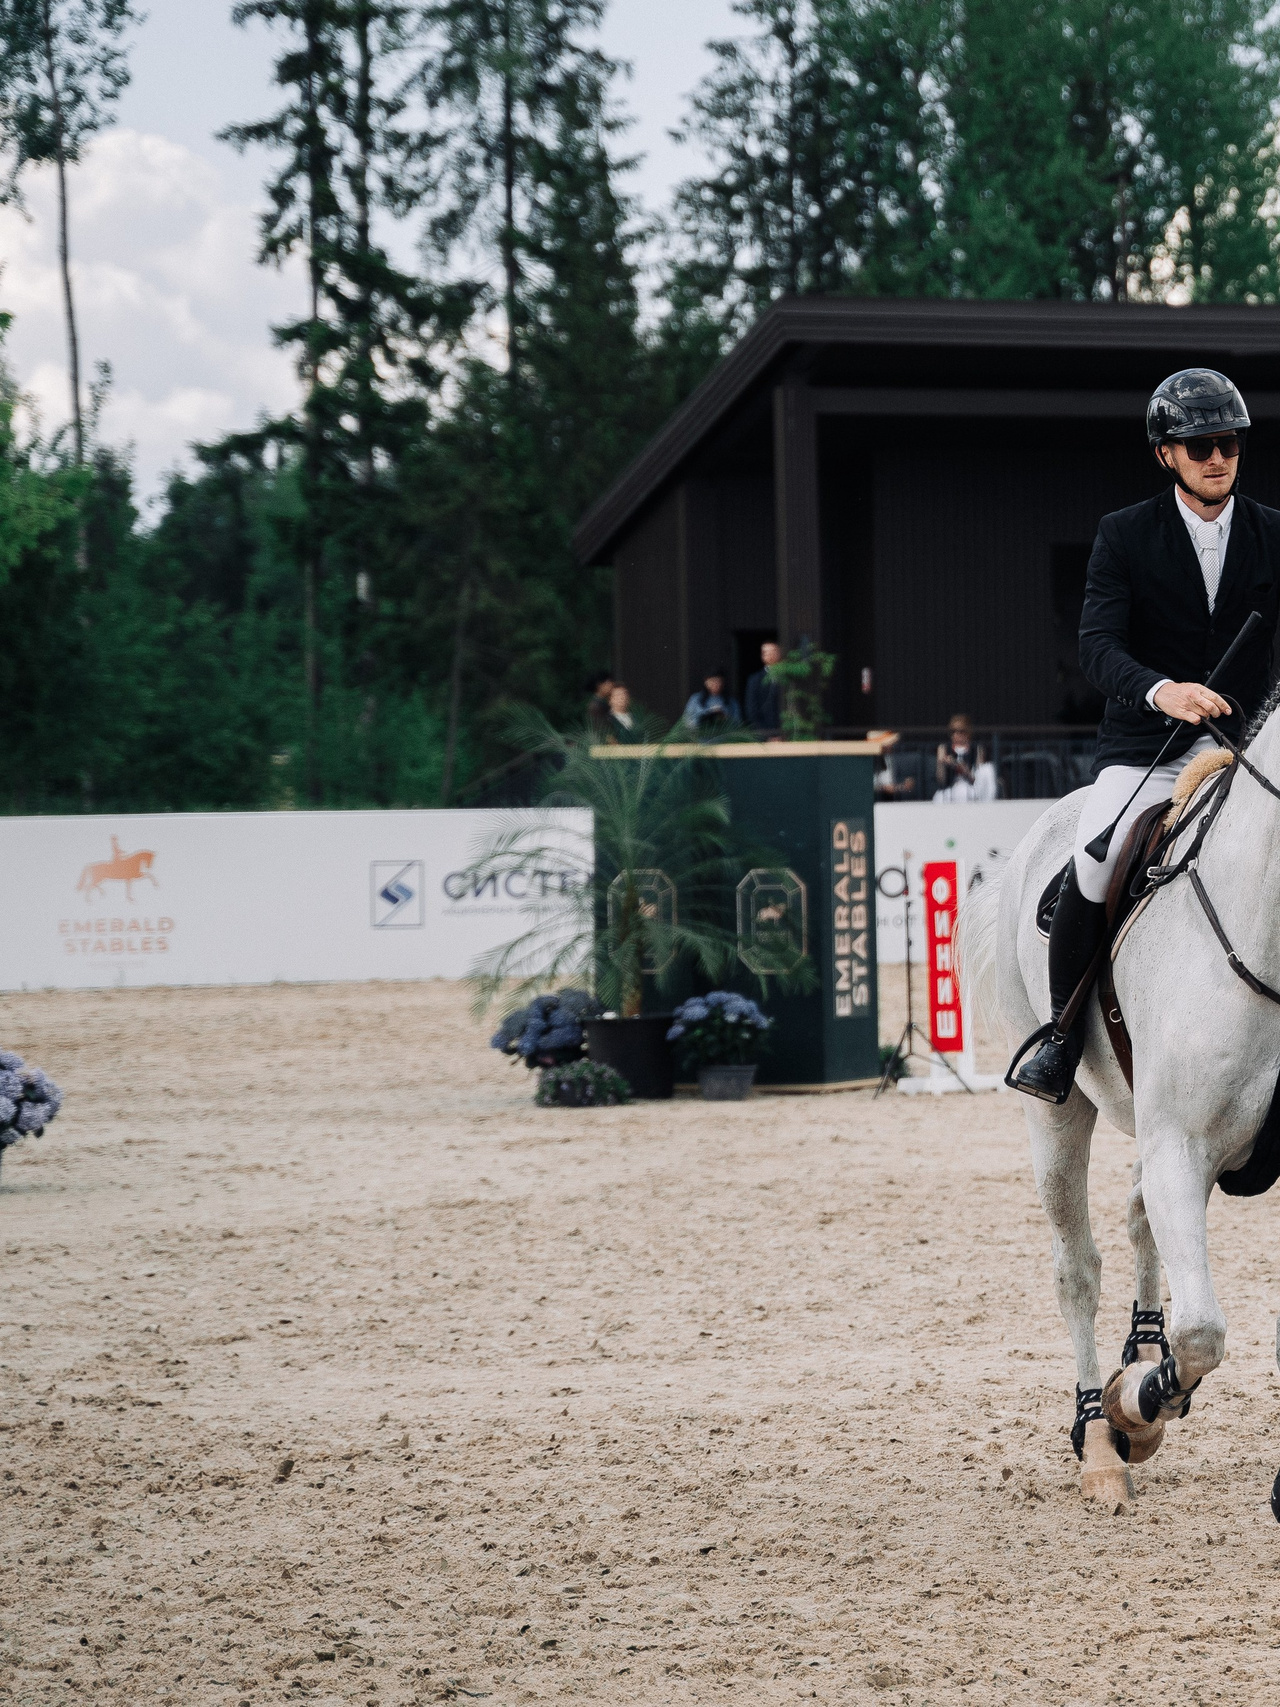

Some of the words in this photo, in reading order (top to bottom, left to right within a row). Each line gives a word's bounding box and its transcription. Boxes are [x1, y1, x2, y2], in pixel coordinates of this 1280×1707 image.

[64, 937, 169, 954] STABLES
[833, 821, 850, 1017] EMERALD
[850, 830, 869, 1006] STABLES
